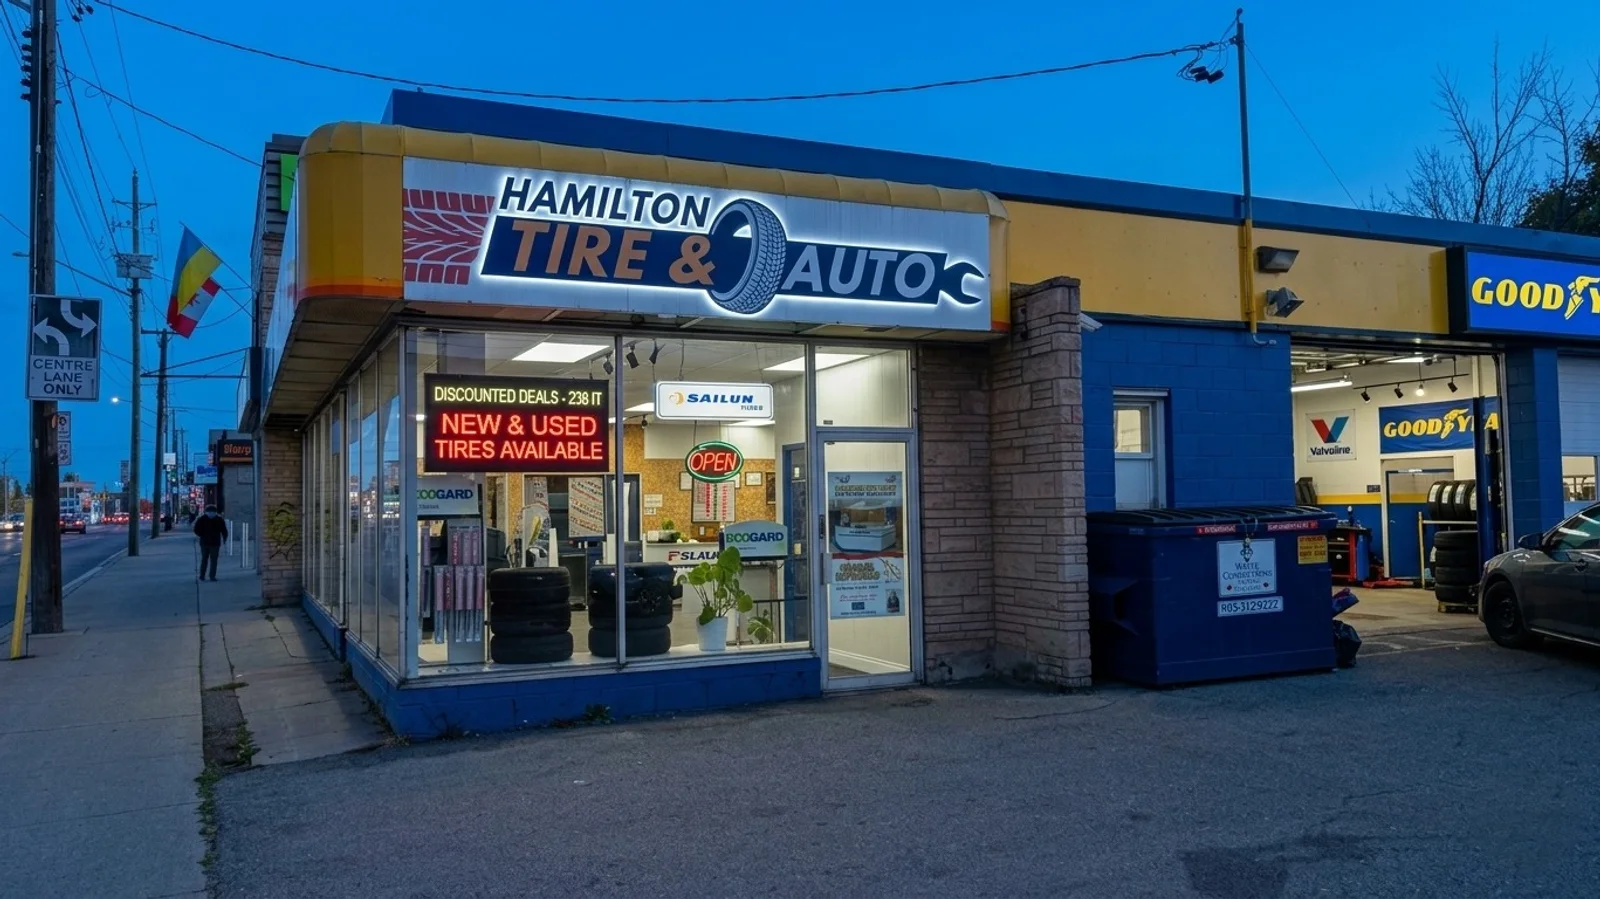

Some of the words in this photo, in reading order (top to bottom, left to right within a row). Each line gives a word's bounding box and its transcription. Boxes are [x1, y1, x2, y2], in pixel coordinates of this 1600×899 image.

[499, 176, 711, 228] HAMILTON
[511, 221, 652, 280] TIRE
[668, 235, 716, 286] &
[781, 248, 936, 299] AUTO
[33, 359, 93, 371] CENTRE
[44, 372, 83, 383] LANE
[43, 383, 82, 395] ONLY
[434, 386, 516, 404] DISCOUNTED
[519, 388, 559, 405] DEALS
[568, 391, 589, 405] 238
[591, 392, 602, 406] IT
[687, 394, 754, 404] SAILUN
[442, 413, 501, 435] NEW
[508, 415, 524, 436] &
[532, 415, 597, 436] USED
[435, 440, 495, 459] TIRES
[500, 440, 603, 460] AVAILABLE
[690, 452, 738, 472] OPEN
